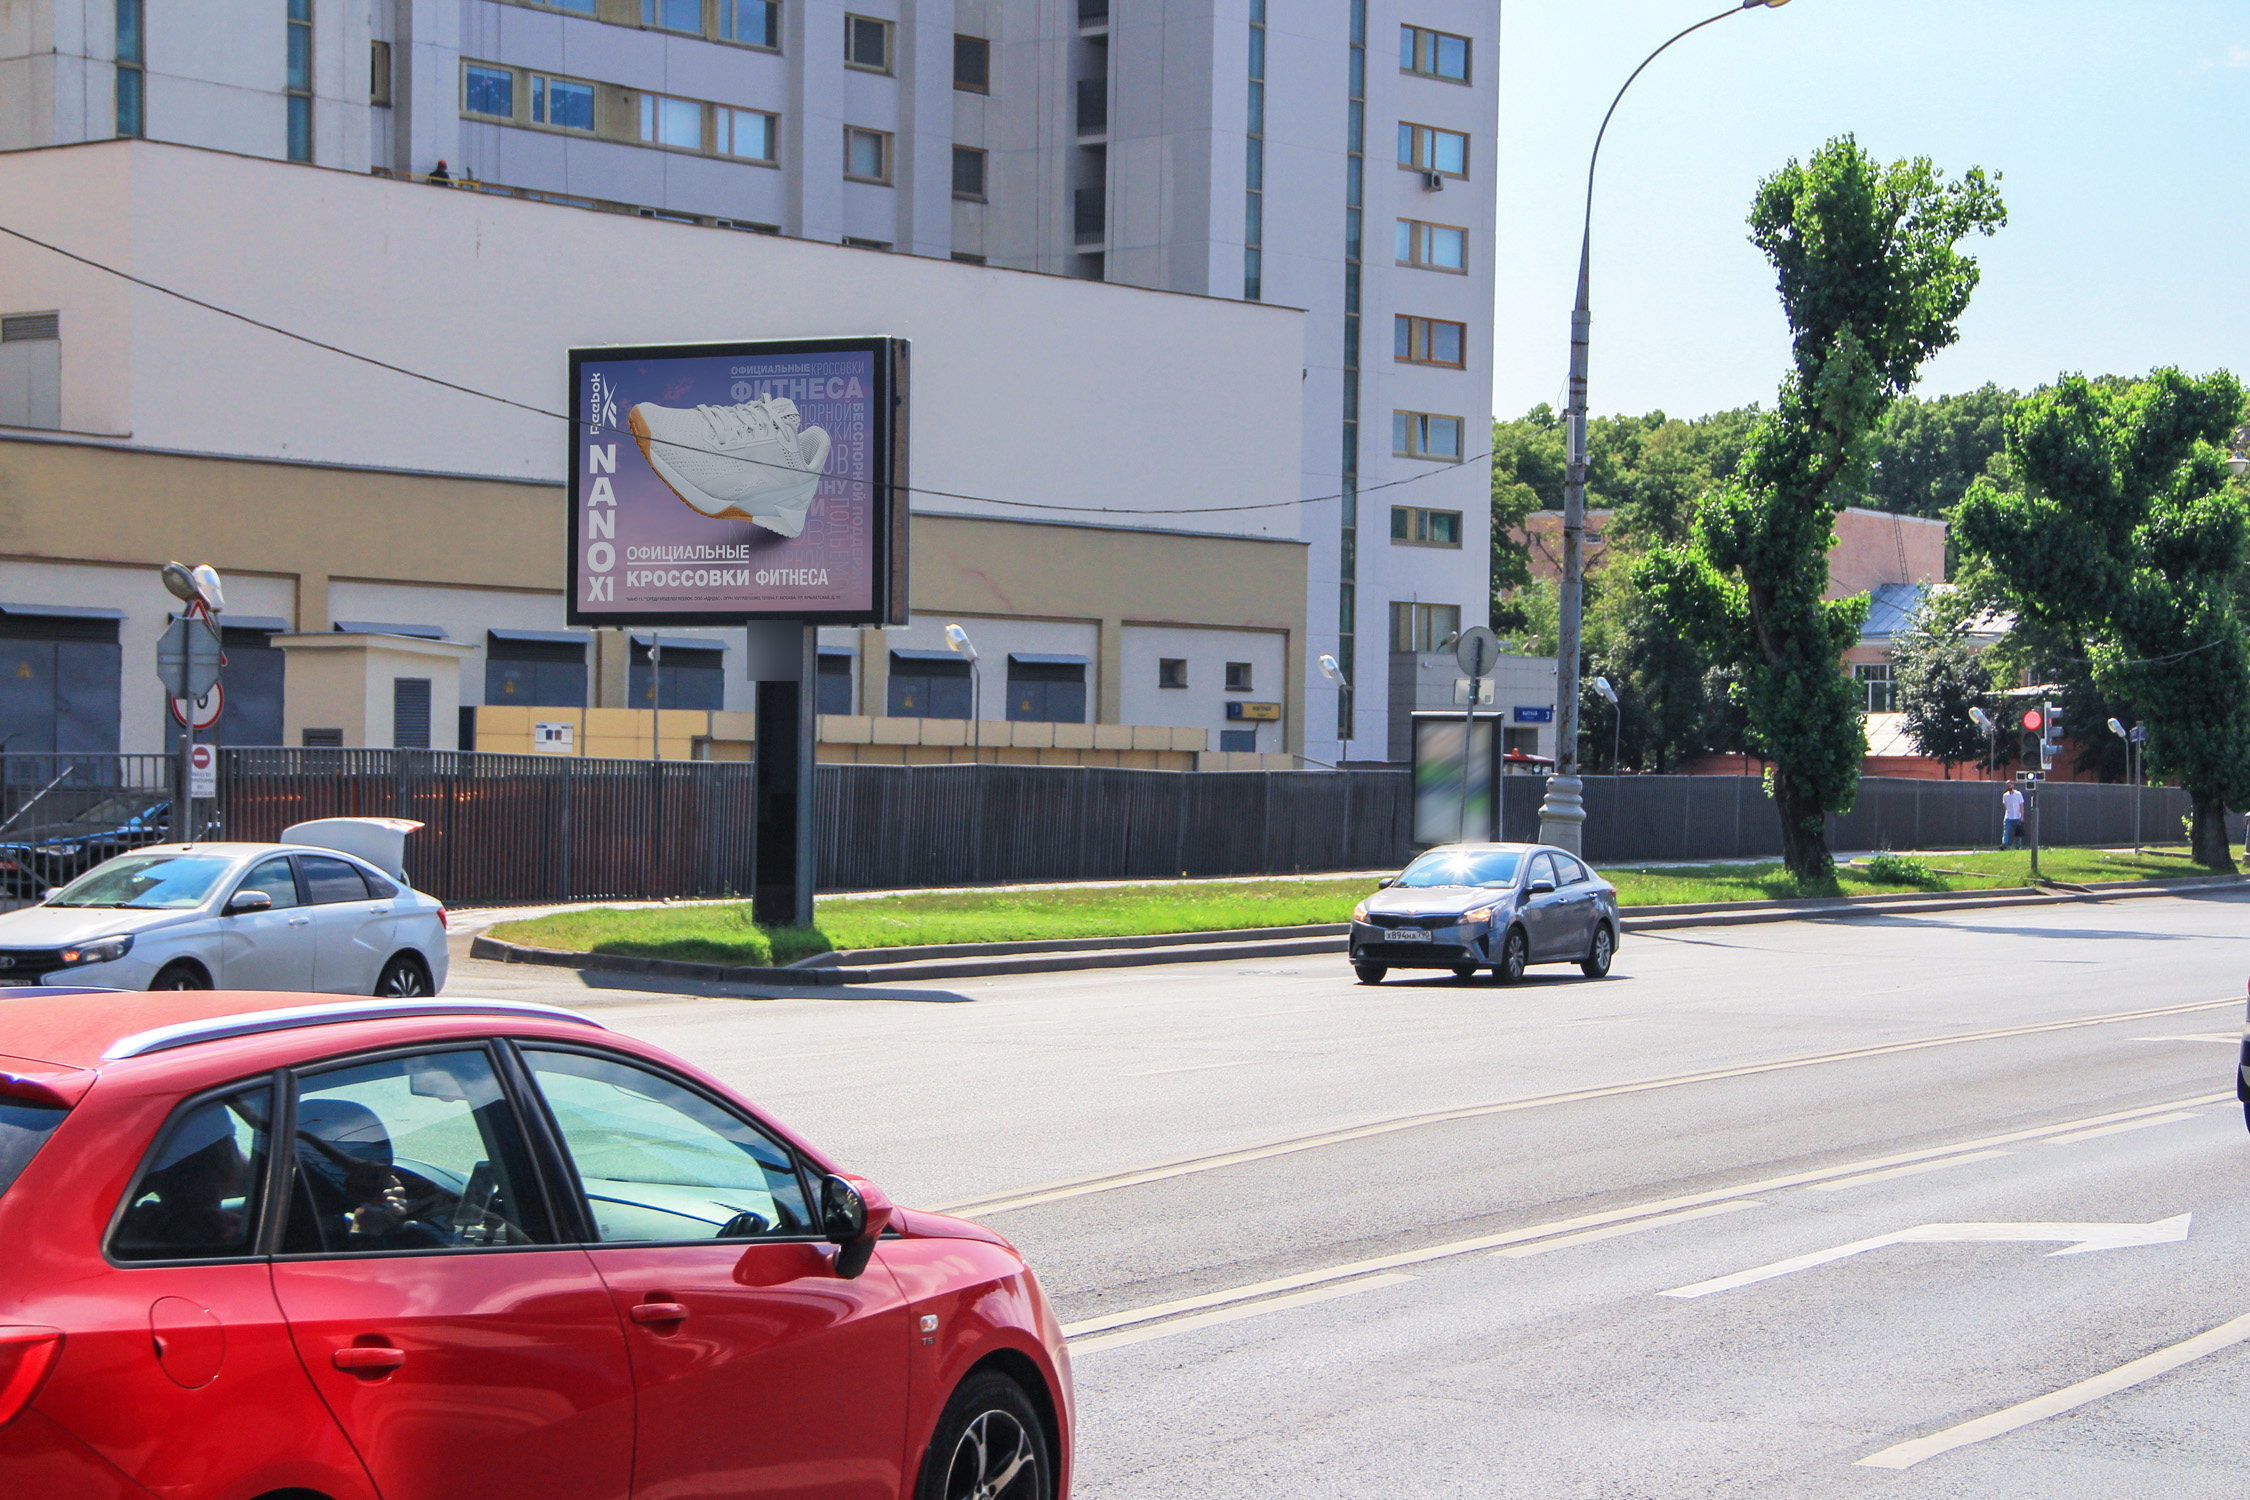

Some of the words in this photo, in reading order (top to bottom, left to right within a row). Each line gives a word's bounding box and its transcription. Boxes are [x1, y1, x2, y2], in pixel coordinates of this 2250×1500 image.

[731, 363, 810, 376] ОФИЦИАЛЬНЫЕ
[811, 361, 865, 375] КРОССОВКИ
[730, 376, 864, 402] ФИТНЕСА
[590, 373, 601, 435] Reebok
[852, 402, 866, 501] БЕССПОРНОЙ
[587, 444, 617, 573] NANO
[626, 545, 749, 562] ОФИЦИАЛЬНЫЕ
[587, 576, 614, 602] X1
[626, 570, 749, 587] КРОССОВКИ
[755, 568, 829, 586] ФИТНЕСА
